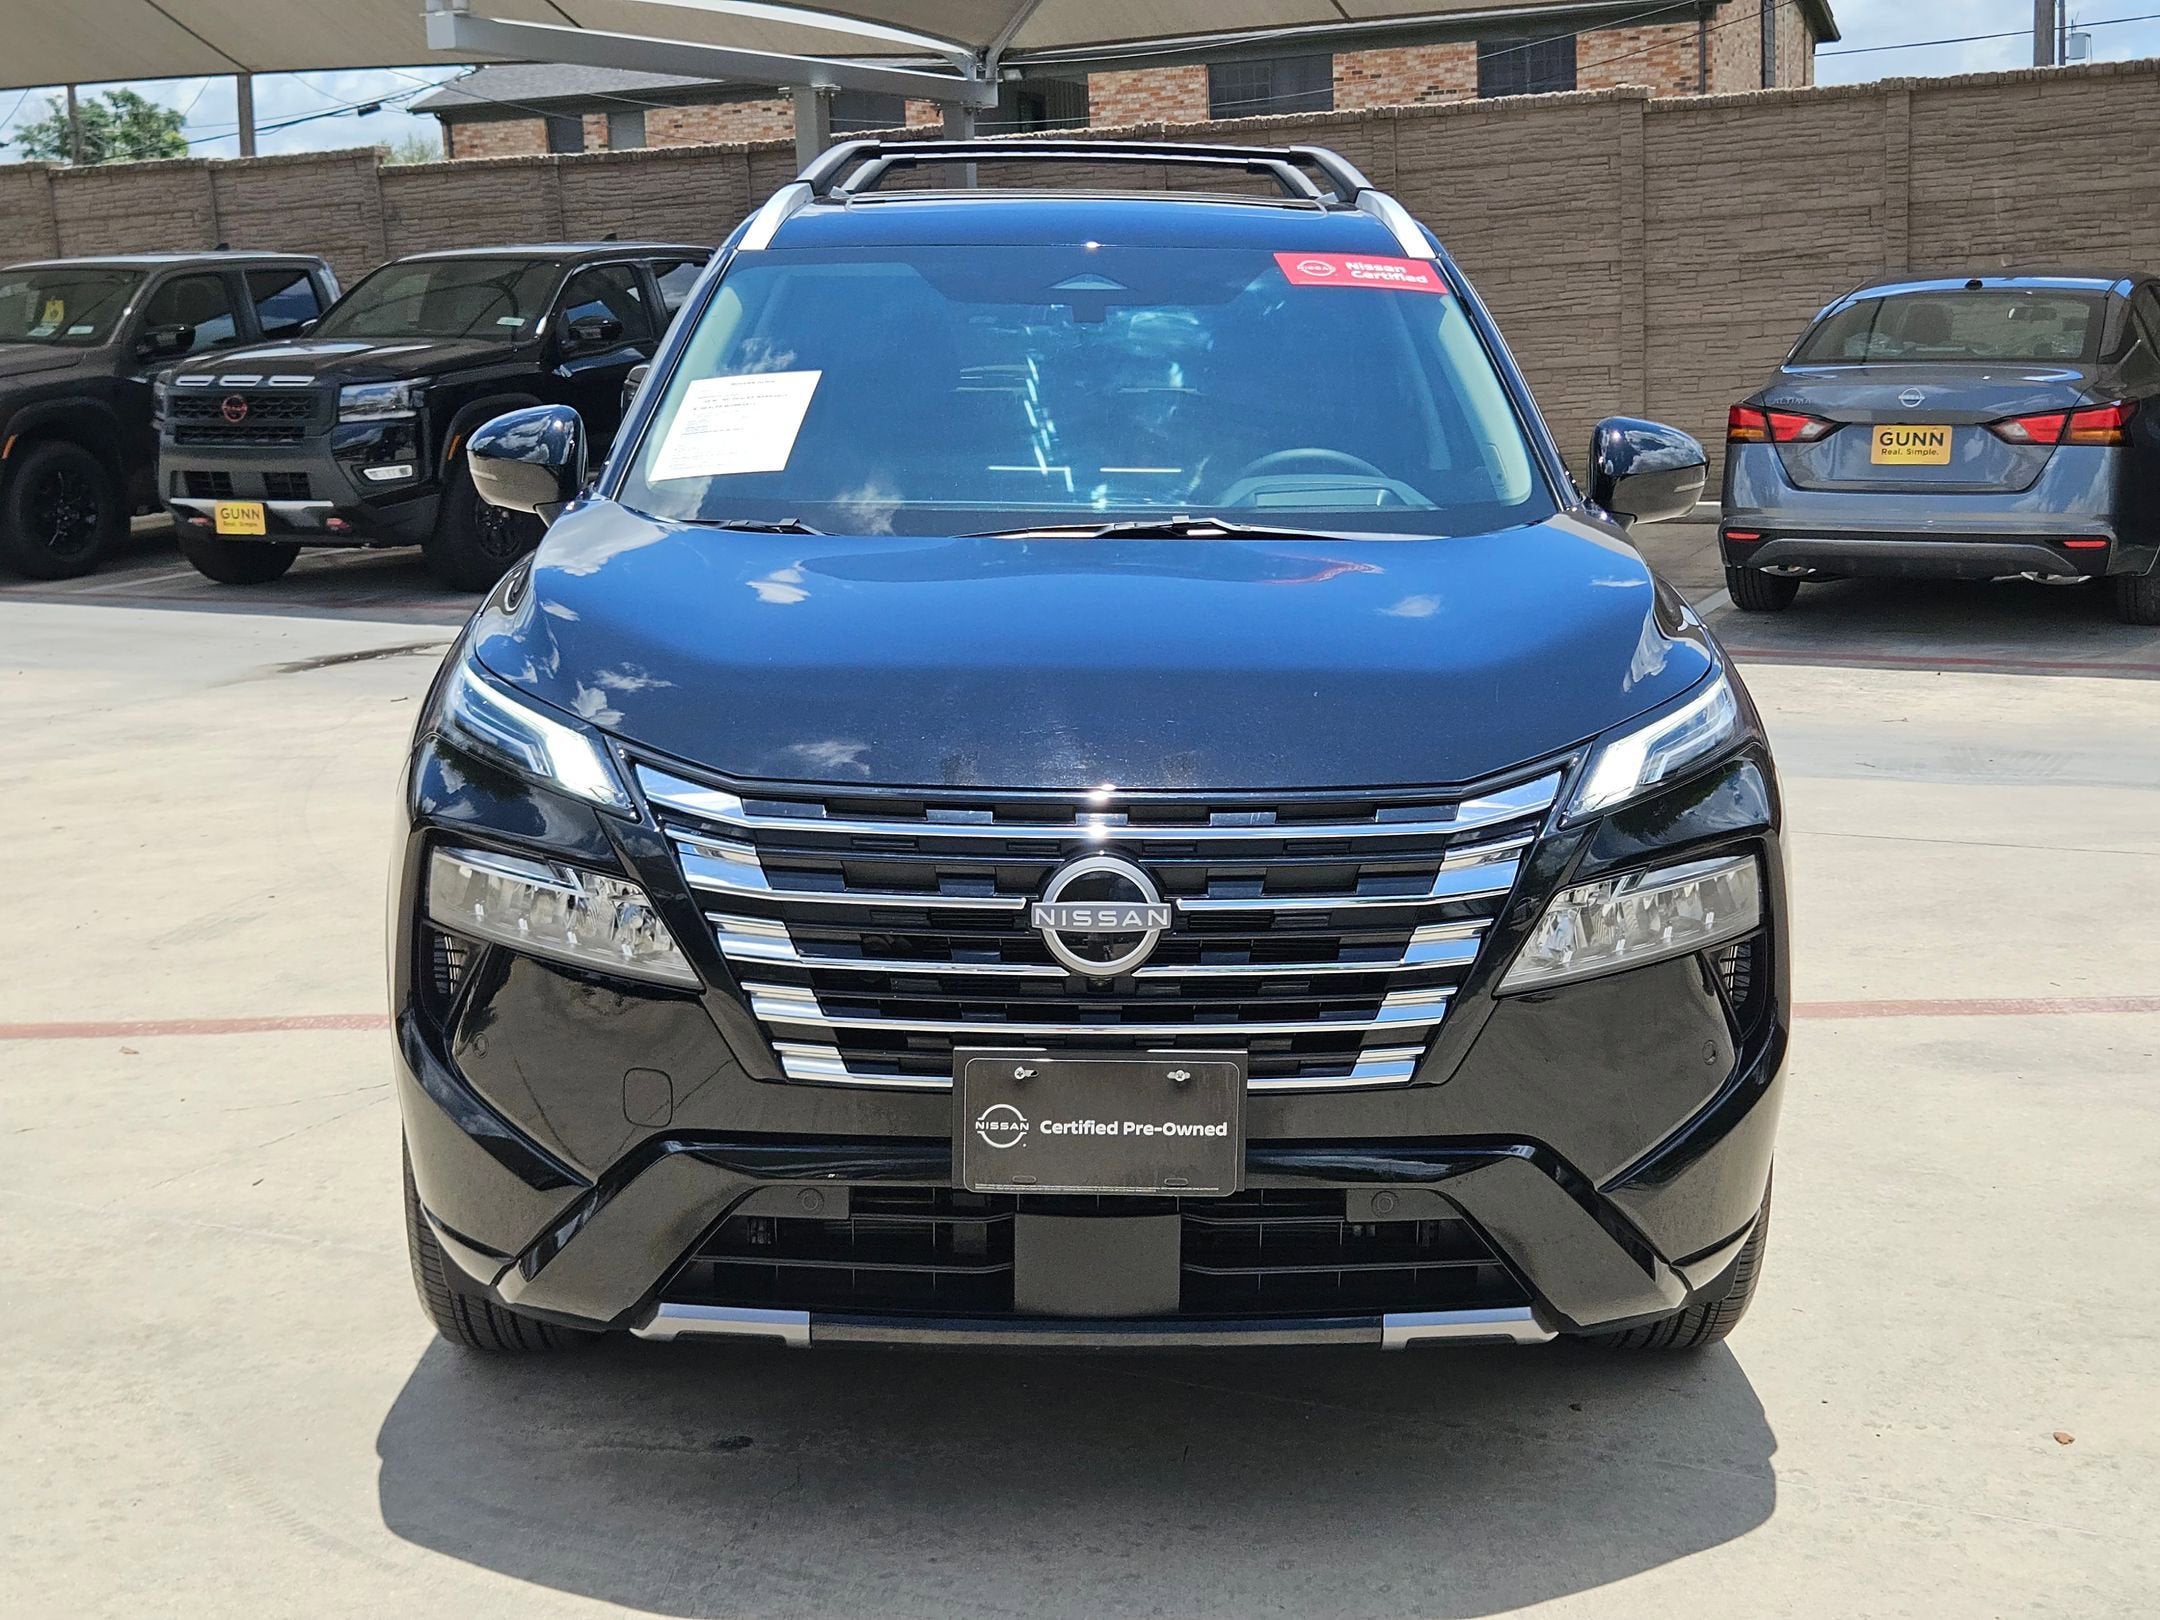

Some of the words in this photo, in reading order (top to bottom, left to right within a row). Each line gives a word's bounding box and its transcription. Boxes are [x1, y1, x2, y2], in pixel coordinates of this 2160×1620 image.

[1345, 261, 1406, 273] Nissan
[1351, 271, 1429, 284] Certified
[1879, 431, 1944, 447] GUNN
[1881, 448, 1903, 456] Real.
[1906, 448, 1940, 457] Simple.
[220, 507, 260, 520] GUNN
[1035, 908, 1168, 927] NISSAN
[975, 1121, 1030, 1132] NISSAN
[1039, 1119, 1119, 1136] Certified
[1123, 1121, 1228, 1138] Pre-Owned
